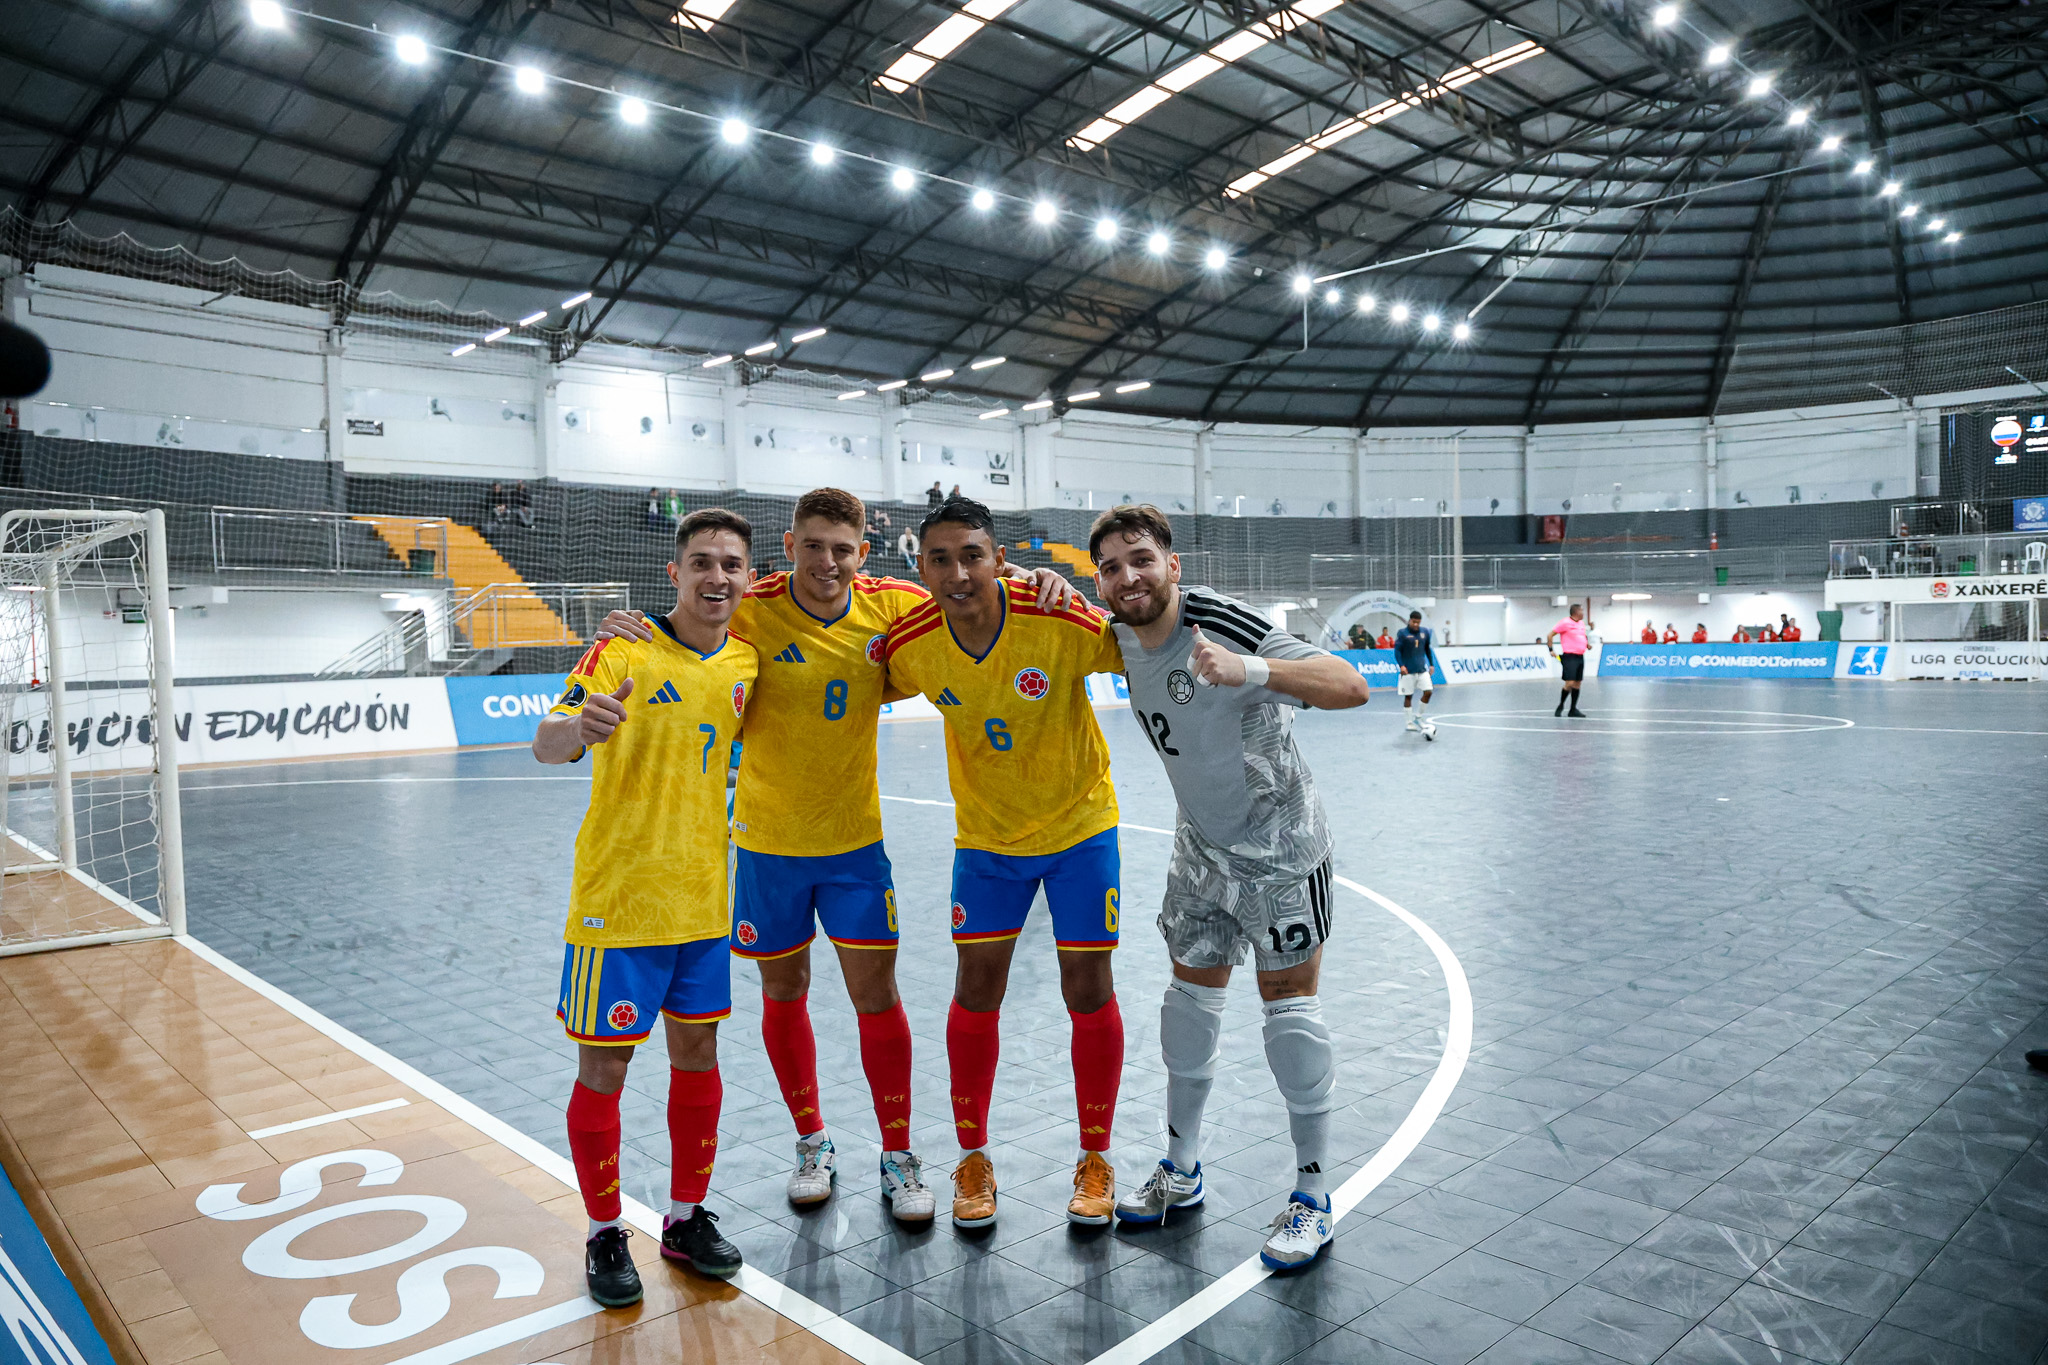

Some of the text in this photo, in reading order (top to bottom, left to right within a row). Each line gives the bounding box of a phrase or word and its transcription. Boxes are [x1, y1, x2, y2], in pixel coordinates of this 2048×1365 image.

[1955, 579, 2048, 597] XANXERÊ
[1605, 653, 1828, 669] SÍGUENOS EN @CONMEBOLTorneos
[1911, 654, 1946, 664] LIGA
[823, 679, 849, 721] 8
[206, 693, 410, 742] EDUCACIÓN
[984, 717, 1013, 751] 6
[1137, 709, 1180, 756] 12
[698, 723, 717, 775] 7
[884, 888, 899, 932] 8
[1105, 887, 1119, 933] 6
[792, 1086, 812, 1098] FCF
[884, 1094, 906, 1104] FCF
[1086, 1103, 1109, 1111] FCF
[600, 1152, 618, 1170] FCF
